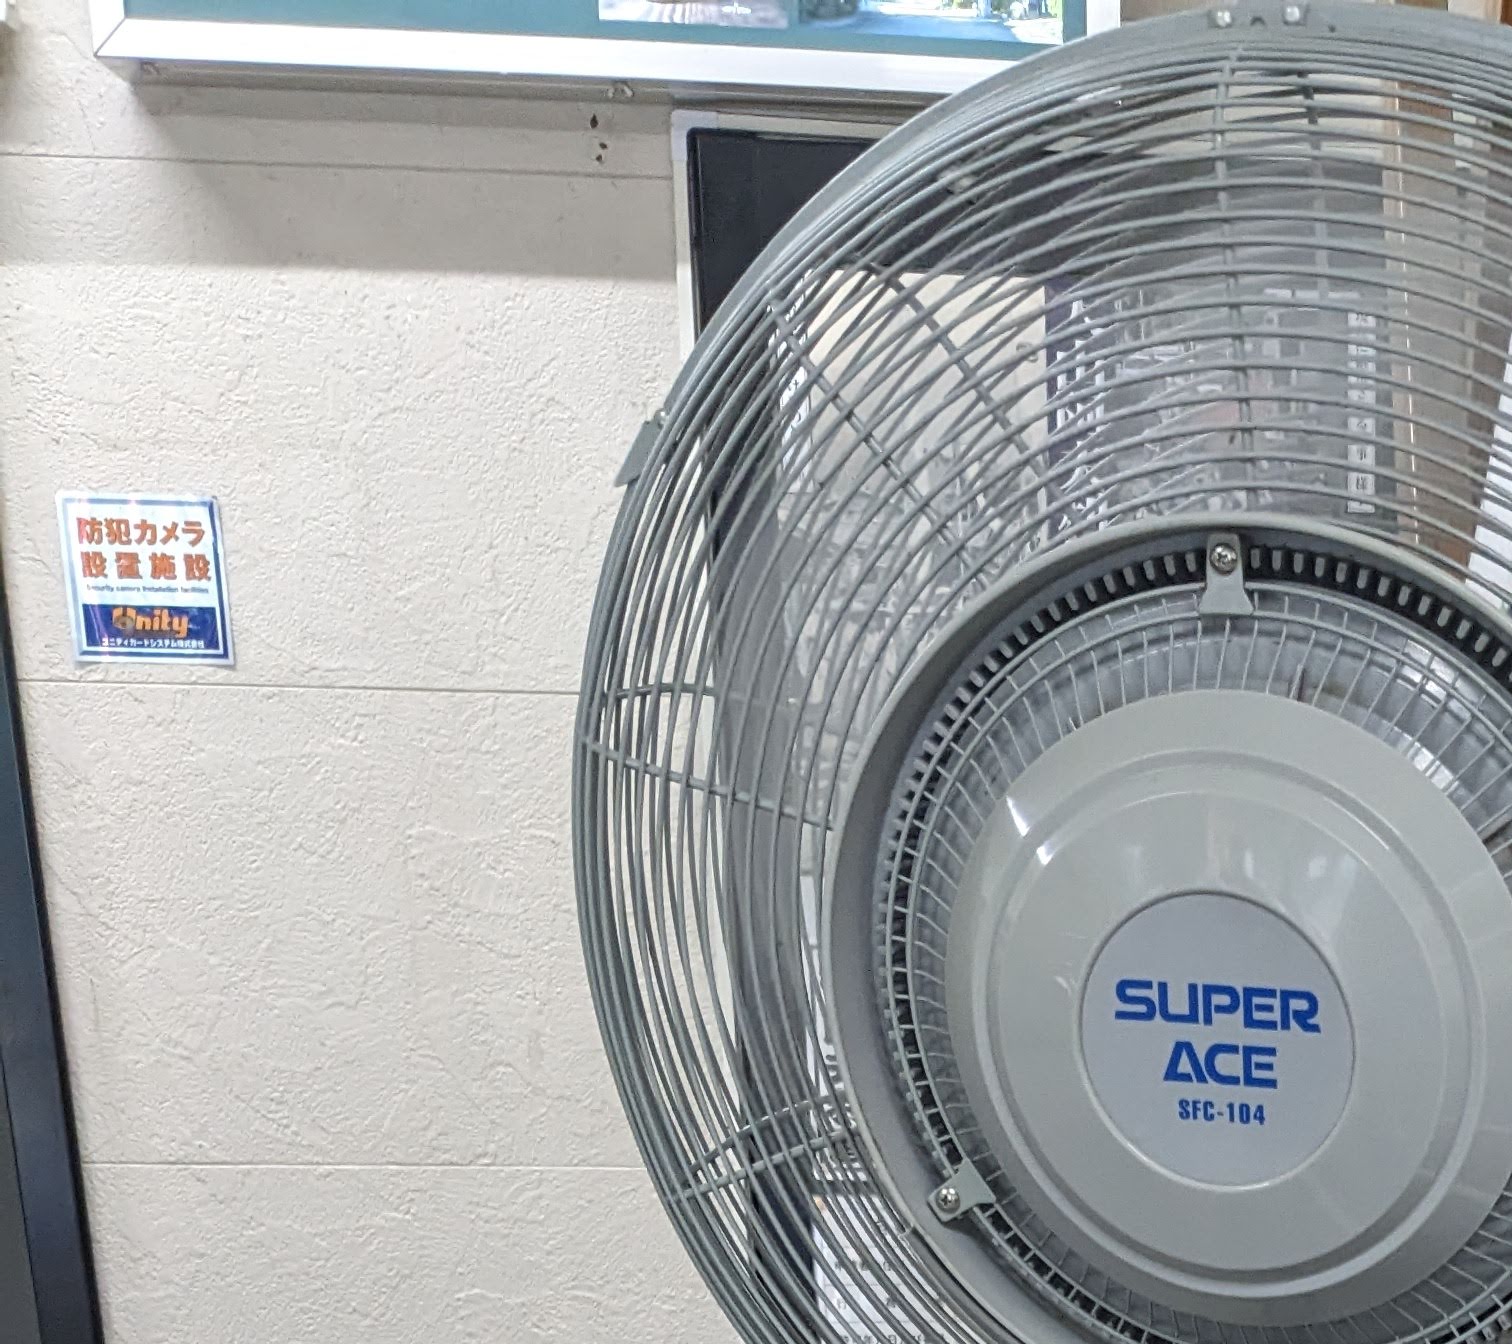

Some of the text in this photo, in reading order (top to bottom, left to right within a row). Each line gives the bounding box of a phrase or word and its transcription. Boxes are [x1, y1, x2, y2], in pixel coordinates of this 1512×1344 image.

[76, 517, 205, 547] 防犯カメラ
[80, 551, 212, 581] 設置施設
[112, 607, 189, 638] Unity
[1115, 979, 1321, 1034] SUPER
[1163, 1040, 1278, 1089] ACE
[1178, 1098, 1266, 1126] SFC-104
